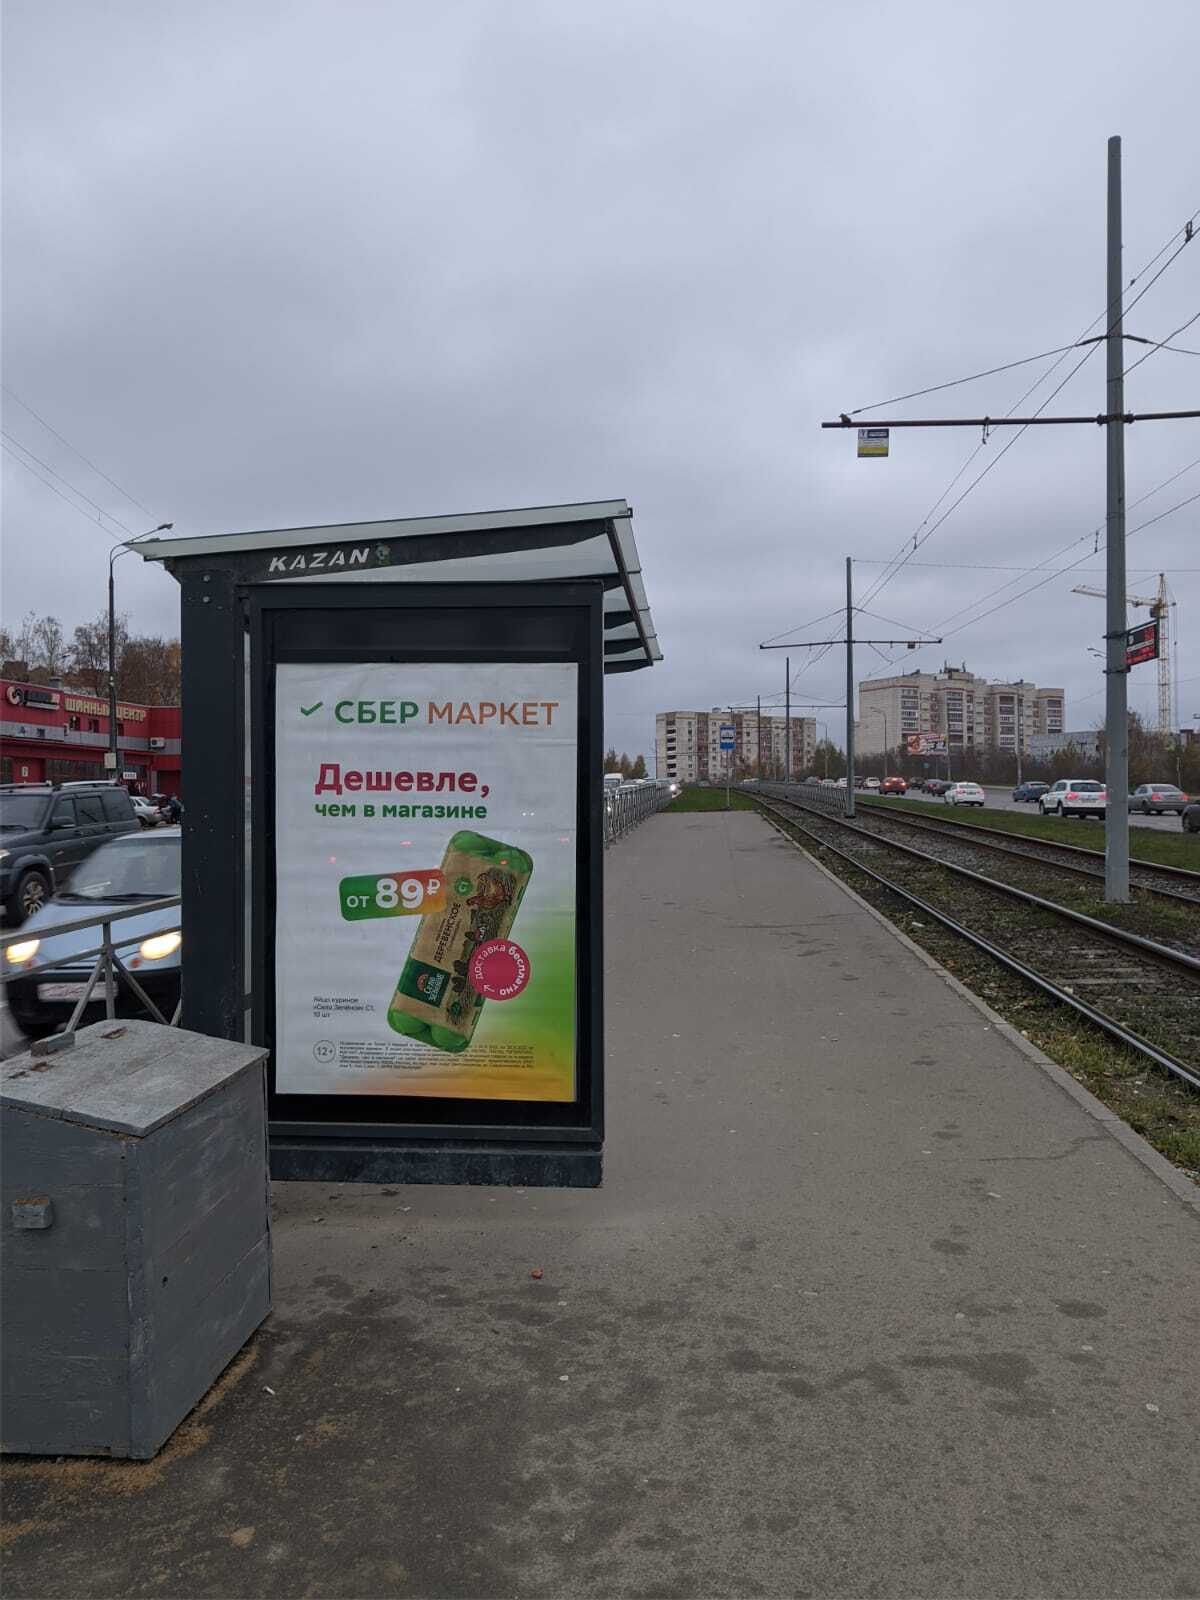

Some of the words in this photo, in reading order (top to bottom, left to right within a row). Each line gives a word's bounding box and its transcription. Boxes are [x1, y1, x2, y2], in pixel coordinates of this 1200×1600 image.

[268, 548, 370, 572] KAZAN
[334, 700, 420, 724] СБЕР
[427, 701, 560, 725] МАРКЕТ
[314, 763, 490, 798] Дешевле,
[314, 803, 356, 817] чем
[363, 804, 375, 818] в
[382, 803, 488, 819] магазине
[346, 895, 370, 908] от
[474, 944, 506, 980] доставка
[499, 945, 526, 996] бесплатно
[316, 1046, 333, 1057] 12+
